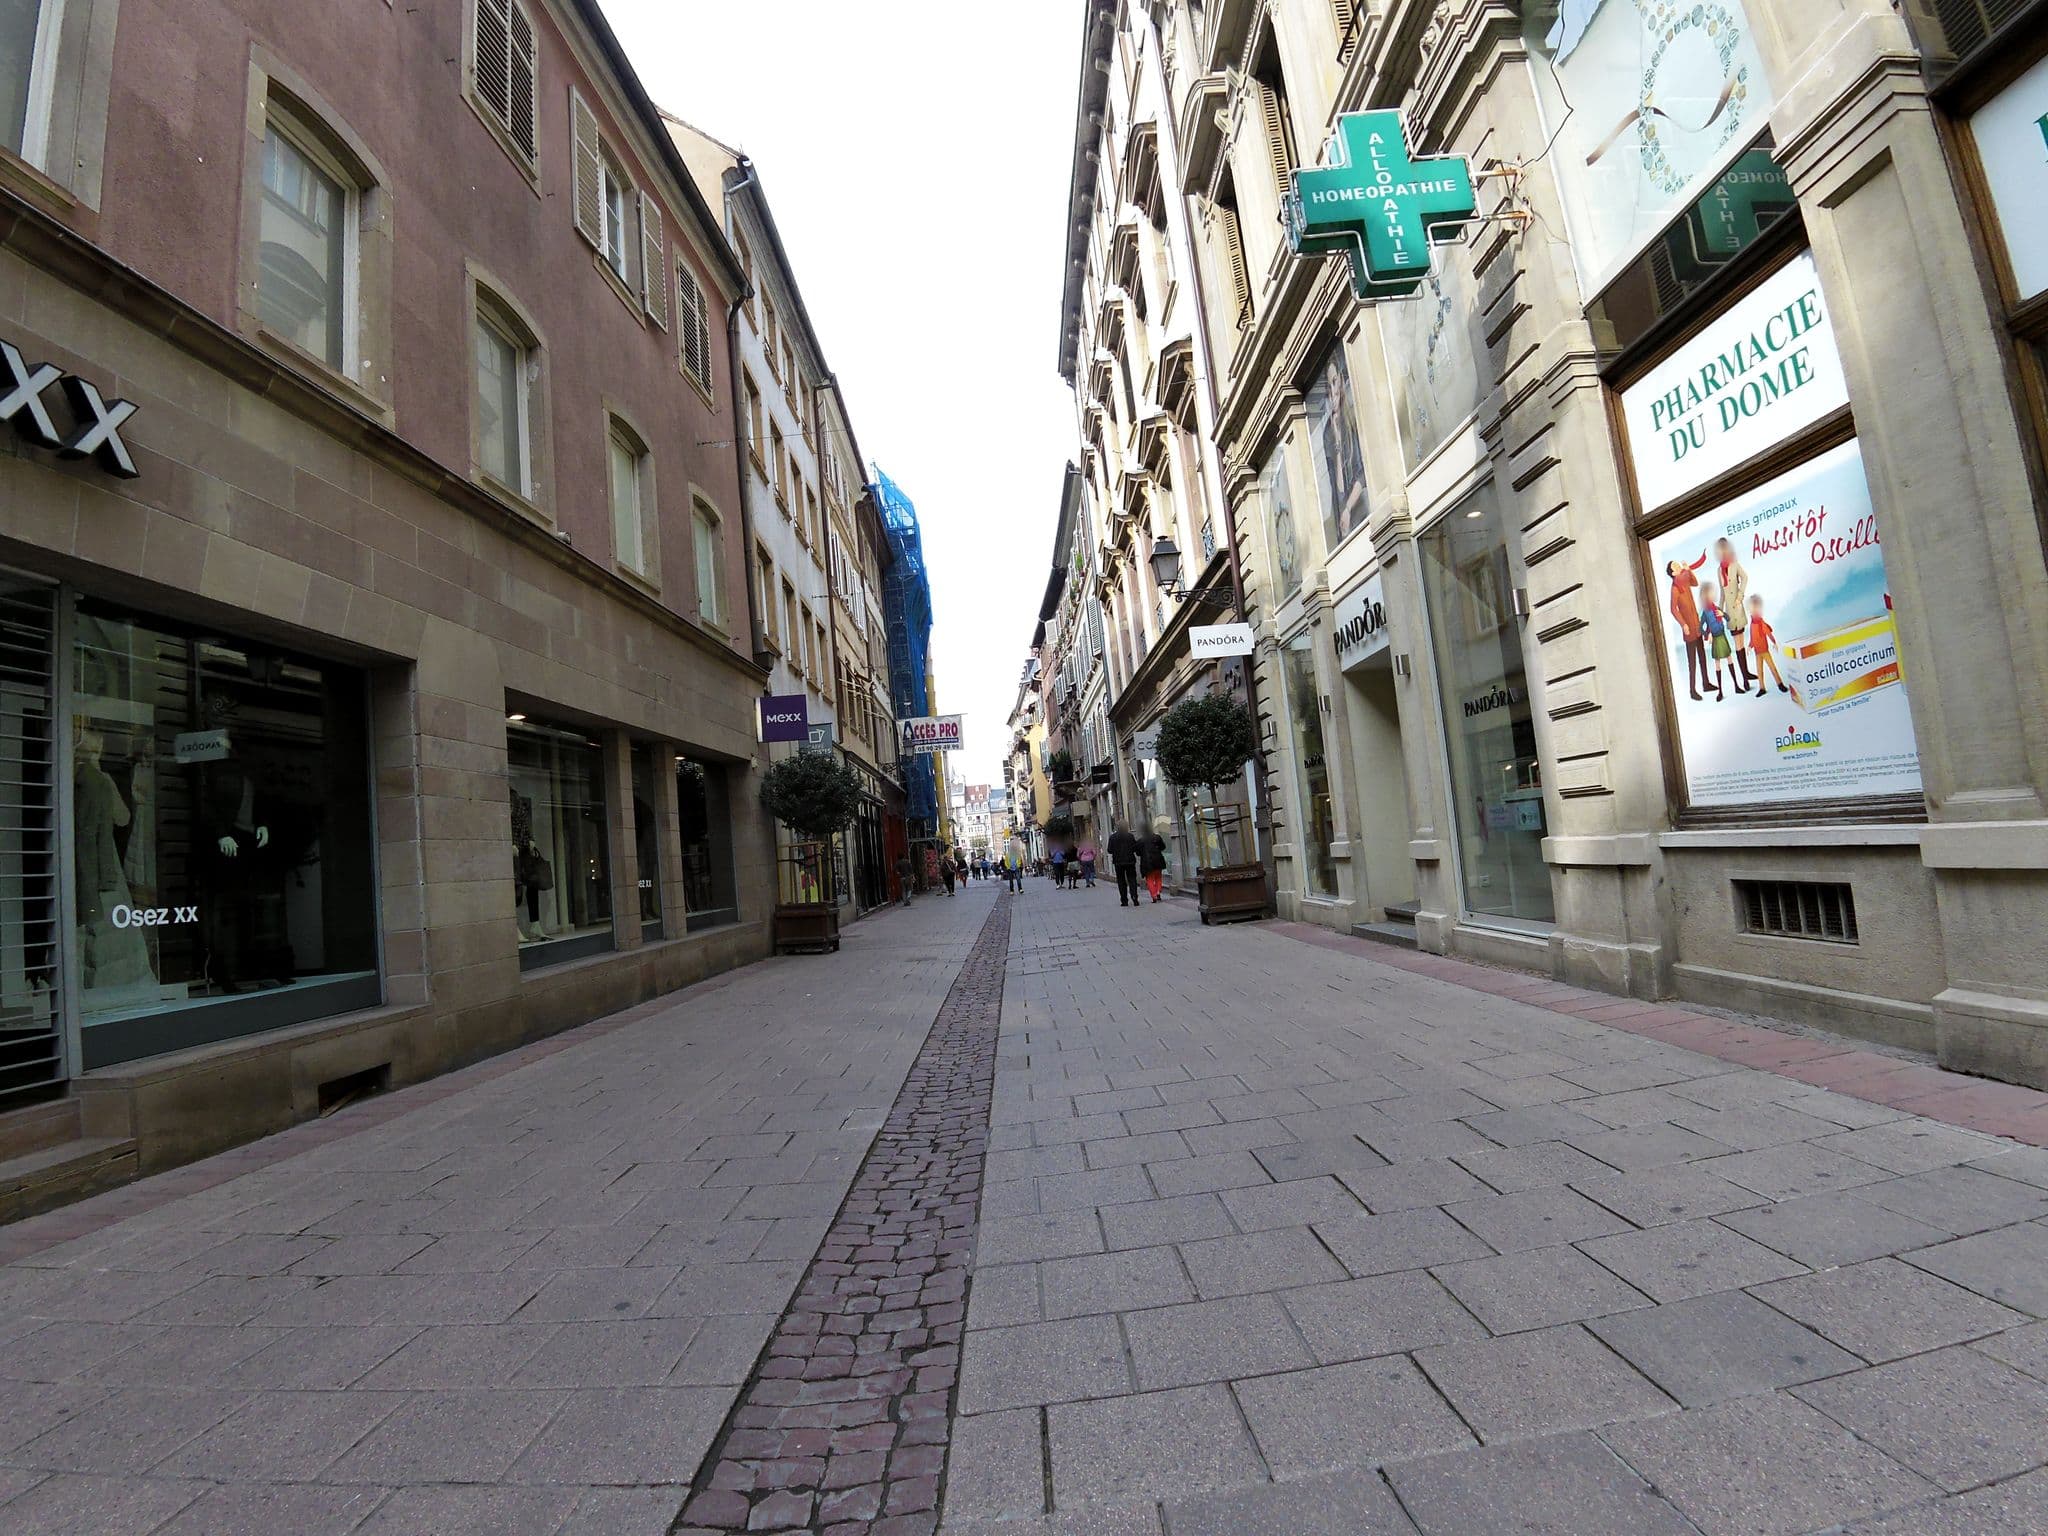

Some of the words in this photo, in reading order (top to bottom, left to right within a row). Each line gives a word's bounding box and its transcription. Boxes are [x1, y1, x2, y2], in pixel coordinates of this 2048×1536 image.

[1312, 179, 1457, 204] HOMEOPATHIE
[1369, 132, 1409, 264] ALLOPATHIE
[1650, 288, 1823, 432] PHARMACIE
[1669, 413, 1706, 462] DU
[1717, 345, 1815, 432] DOME
[1752, 498, 1798, 526] grippaux
[1752, 505, 1828, 560] Aussitôt
[1806, 646, 1895, 684] oscillococcinum
[1808, 688, 1819, 700] 30
[939, 722, 958, 737] PRO
[1776, 726, 1820, 748] BOIRON
[112, 904, 170, 929] Osez
